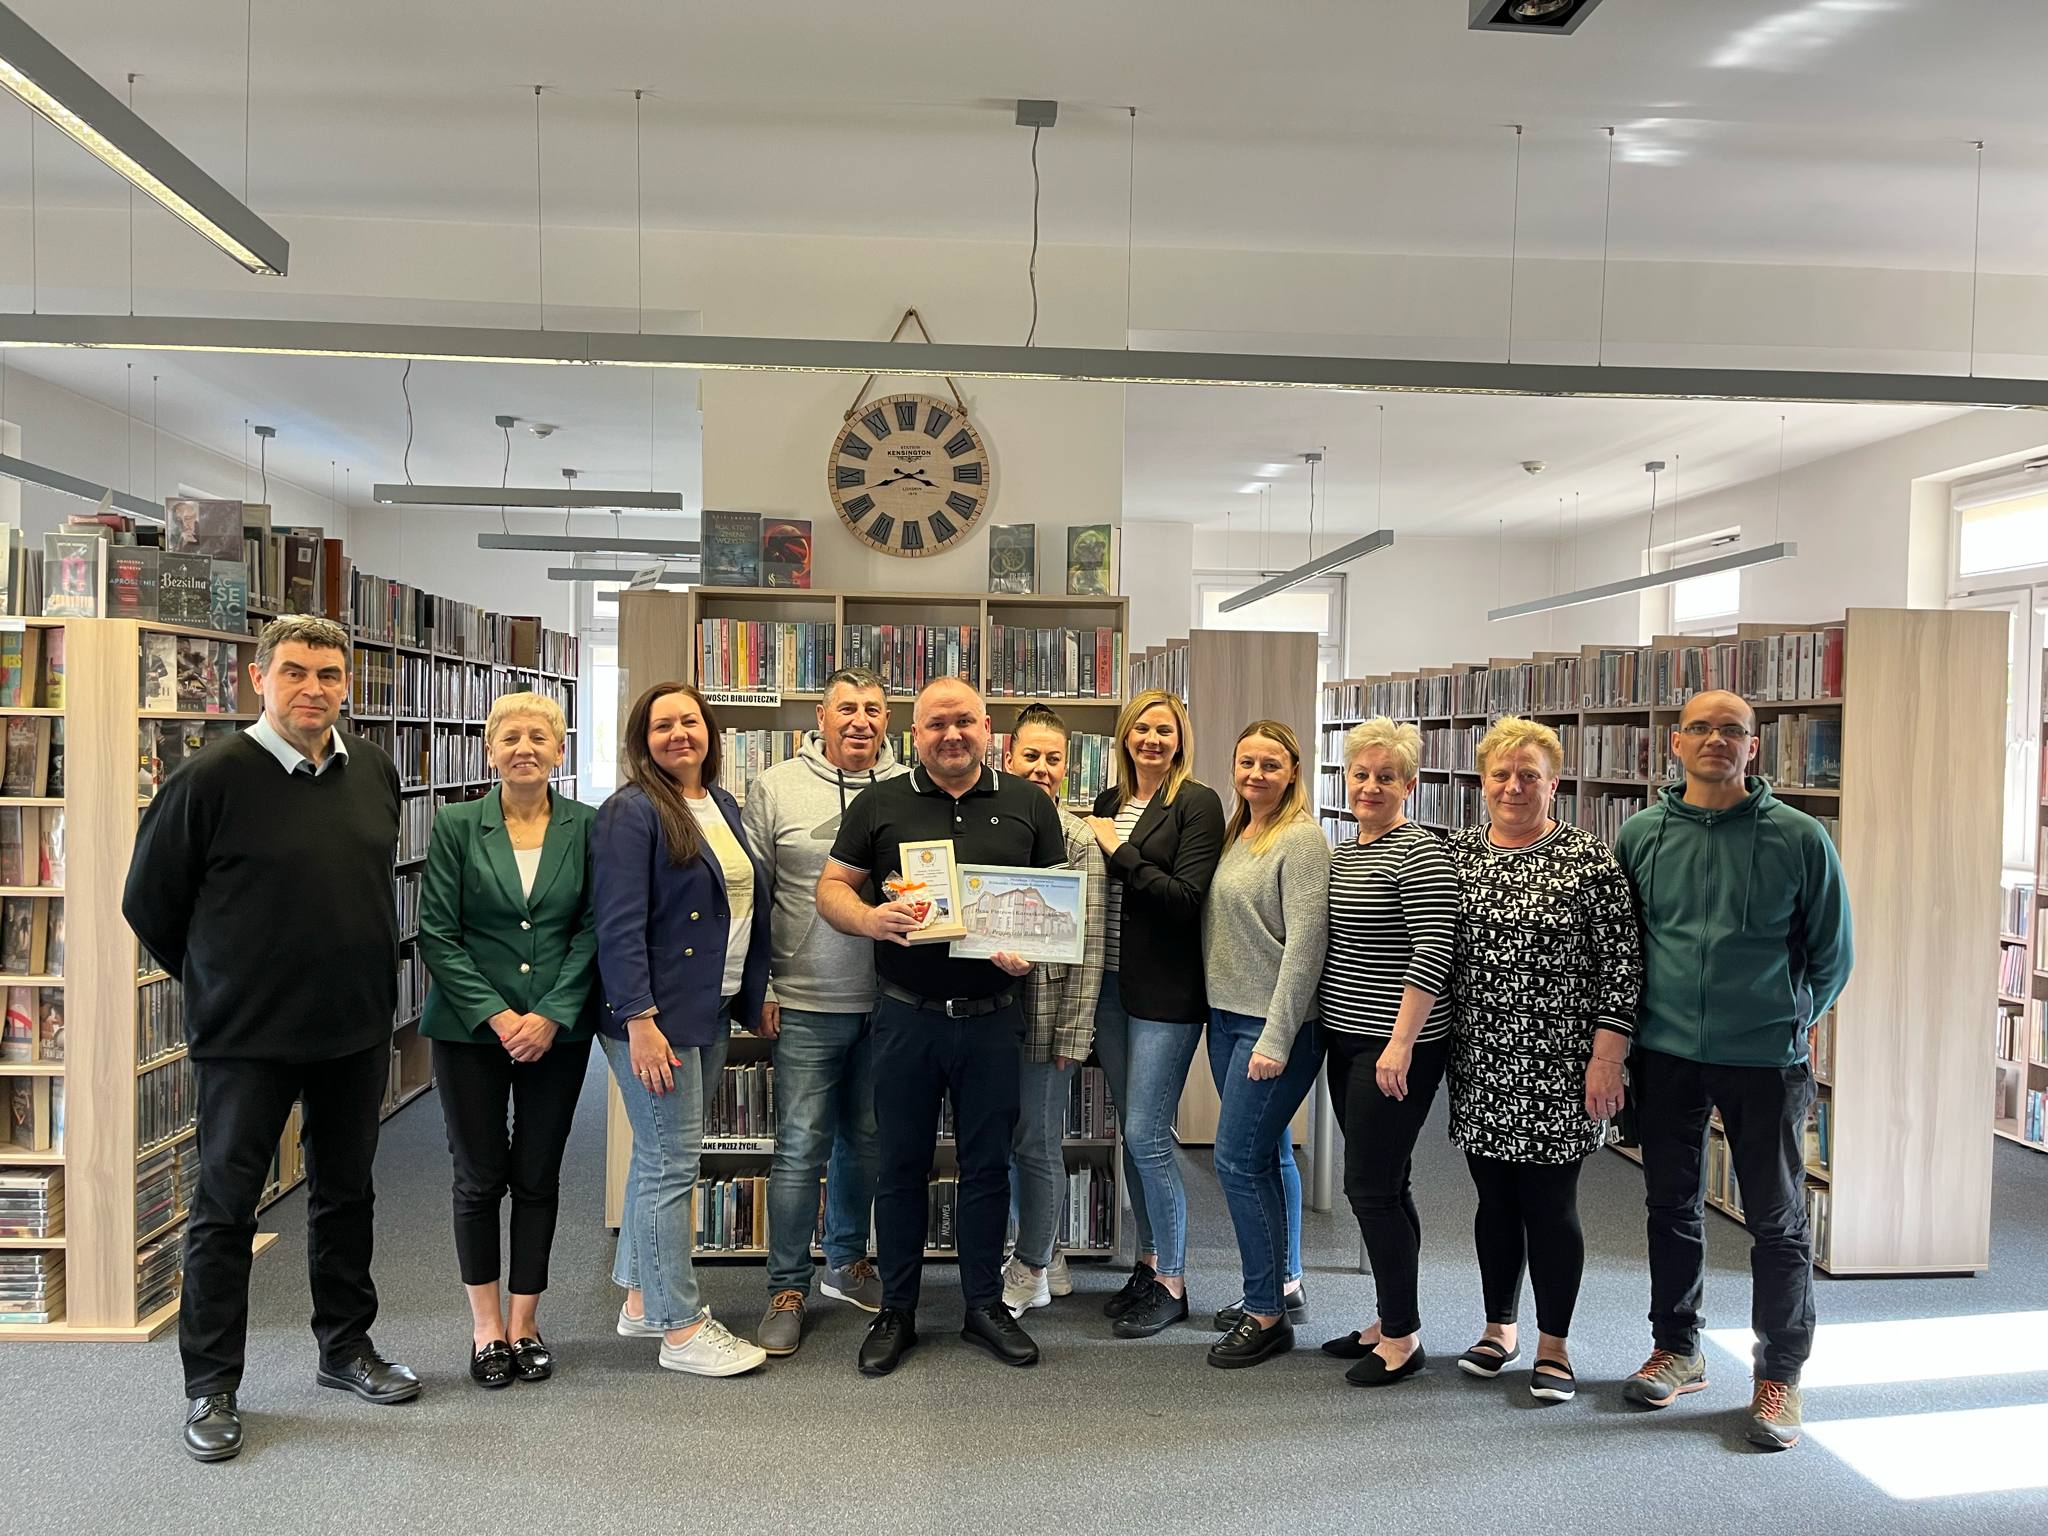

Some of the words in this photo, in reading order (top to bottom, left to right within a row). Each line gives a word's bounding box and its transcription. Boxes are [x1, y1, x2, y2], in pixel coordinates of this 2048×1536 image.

[899, 405, 914, 426] XII
[867, 413, 888, 436] XI
[845, 439, 868, 457] X
[948, 438, 968, 455] II
[840, 471, 861, 483] IX
[958, 467, 978, 480] III
[950, 495, 972, 515] IV
[872, 518, 890, 540] VII
[906, 525, 920, 545] VI
[936, 517, 951, 536] V
[160, 572, 207, 590] Bezsilna
[216, 588, 240, 602] SE
[214, 602, 241, 617] AC
[852, 632, 860, 649] ETER
[730, 694, 778, 704] BIBLIOTECZNE
[717, 1142, 738, 1150] PRZEZ
